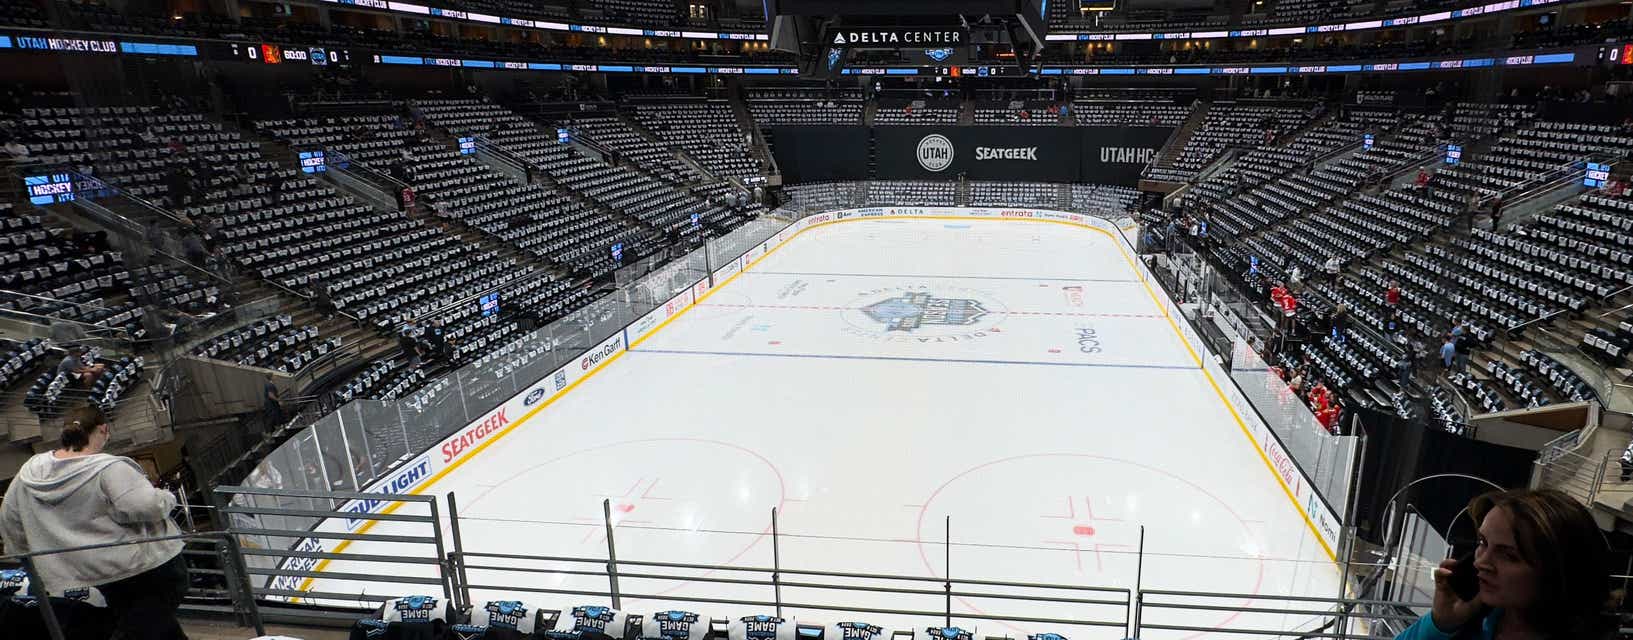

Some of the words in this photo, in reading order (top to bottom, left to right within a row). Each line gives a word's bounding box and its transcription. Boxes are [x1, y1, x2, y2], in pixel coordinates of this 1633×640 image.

[850, 32, 898, 43] DELTA
[904, 32, 960, 43] CENTER
[16, 36, 48, 49] UTAH
[48, 38, 90, 51] HOCKEY
[90, 41, 117, 53] CLUB
[247, 47, 257, 59] 0
[330, 51, 338, 62] 0
[1610, 48, 1619, 61] 0
[922, 147, 947, 160] UTAH
[975, 146, 1037, 161] SEATGEEK
[1100, 147, 1135, 163] UTAH
[1136, 148, 1154, 163] HC
[33, 182, 71, 195] HOCKEY
[897, 208, 924, 216] DELTA
[1001, 210, 1034, 218] entrata
[1077, 327, 1104, 354] PACS
[588, 351, 604, 367] Ken
[603, 336, 622, 357] Garff
[441, 407, 509, 464] SEATGEEK
[403, 610, 429, 619] GAME
[490, 612, 518, 624] GAME
[576, 617, 605, 629] GAME
[661, 621, 689, 631] GAME
[747, 622, 776, 632] GAME
[845, 627, 872, 640] GAME
